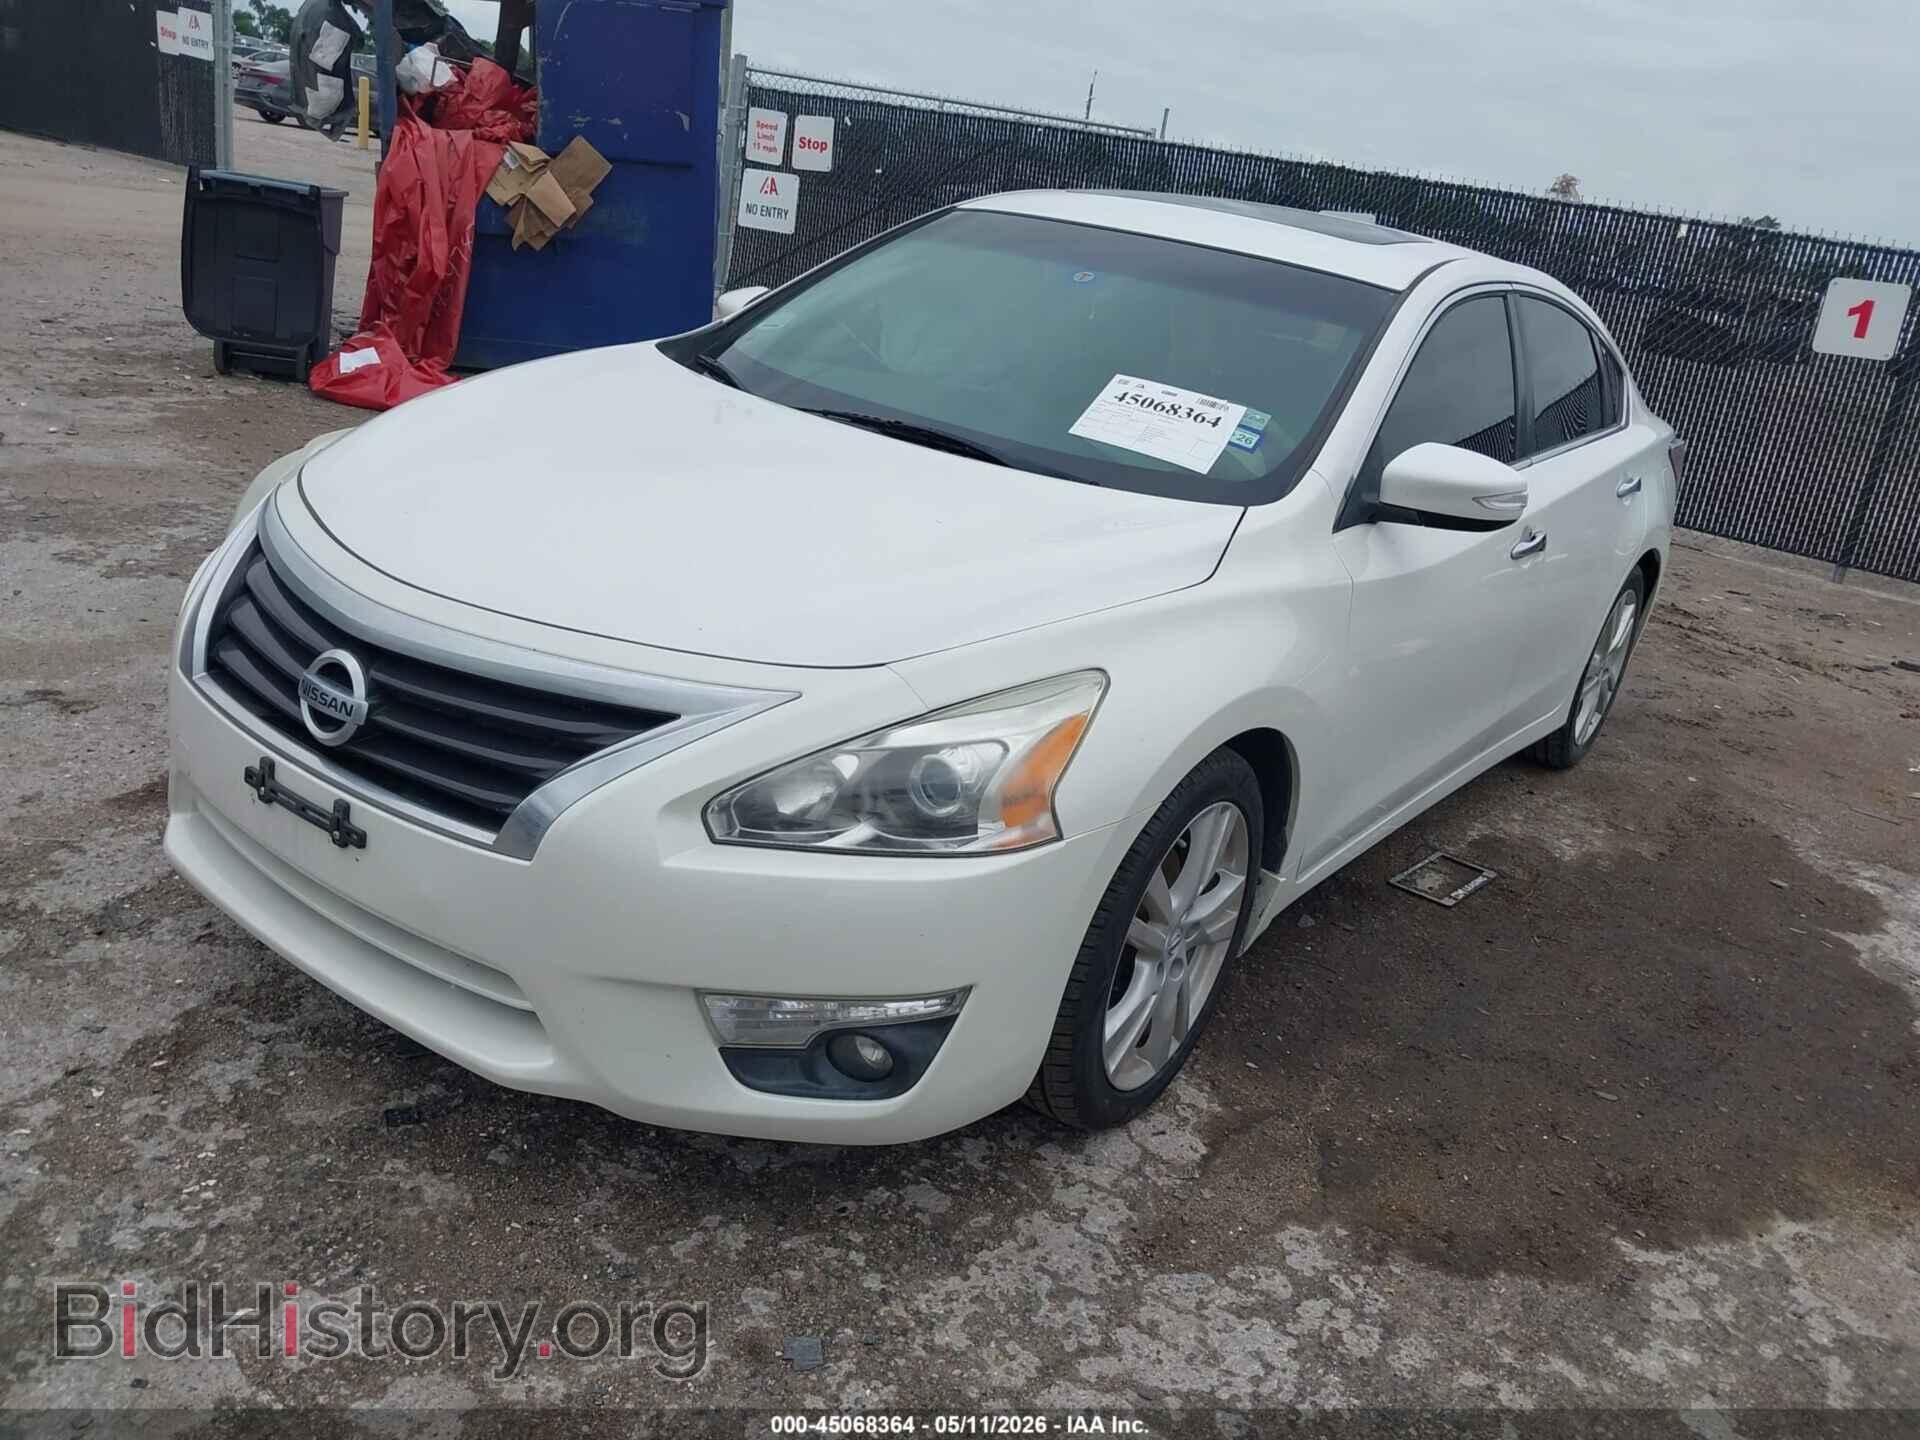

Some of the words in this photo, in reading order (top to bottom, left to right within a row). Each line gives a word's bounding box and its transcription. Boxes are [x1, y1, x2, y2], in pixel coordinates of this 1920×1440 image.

[756, 120, 778, 131] Speed
[757, 131, 775, 141] Limit
[799, 137, 828, 153] Stop
[746, 202, 758, 215] NO
[760, 205, 789, 220] ENTRY
[1847, 299, 1875, 339] 1
[1114, 391, 1222, 428] 45068364
[303, 685, 354, 718] NISSAN
